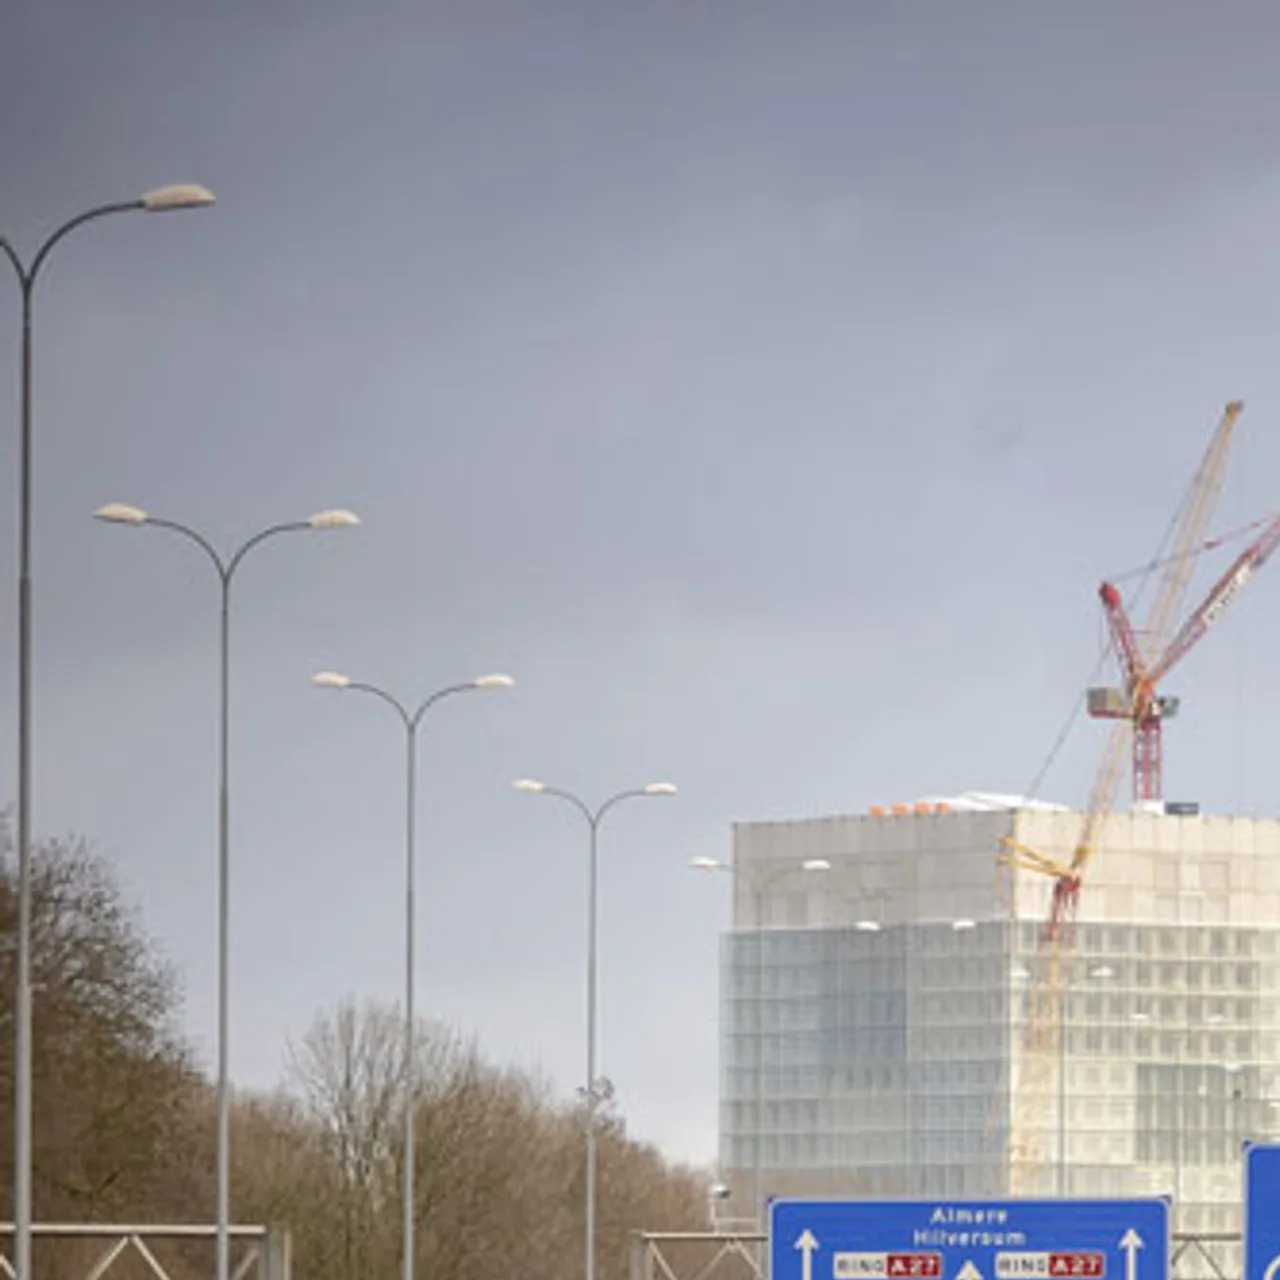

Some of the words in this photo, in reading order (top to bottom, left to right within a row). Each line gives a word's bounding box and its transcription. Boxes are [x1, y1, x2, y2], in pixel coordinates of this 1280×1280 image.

[930, 1207, 1009, 1225] Almere
[913, 1229, 1027, 1247] Hilversum
[890, 1257, 937, 1274] A27
[1053, 1257, 1100, 1274] A27
